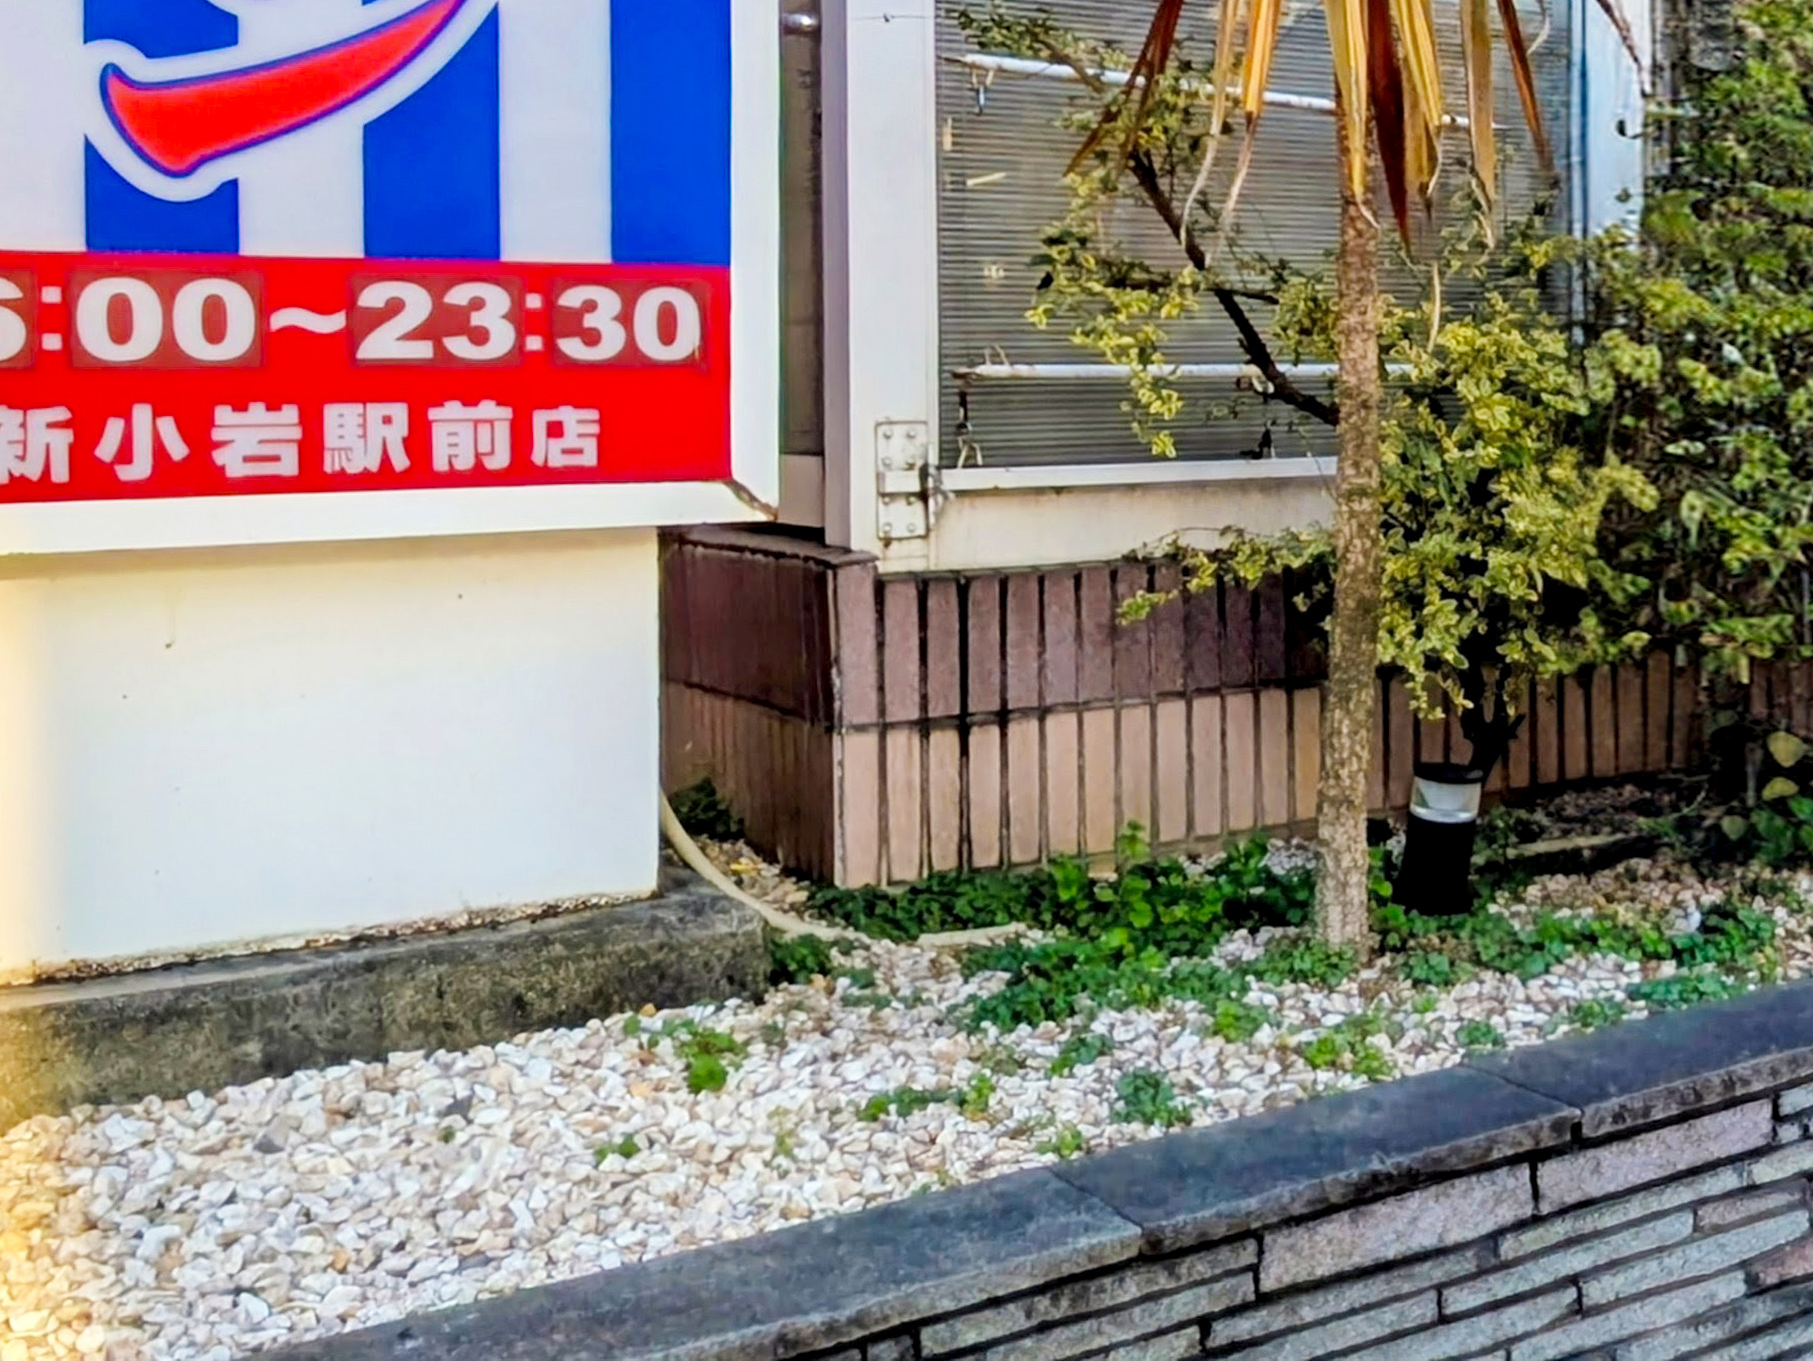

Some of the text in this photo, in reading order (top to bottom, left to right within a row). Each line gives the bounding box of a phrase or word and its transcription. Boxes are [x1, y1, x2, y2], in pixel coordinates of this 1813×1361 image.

[0, 400, 600, 485] 新小岩駅前店
